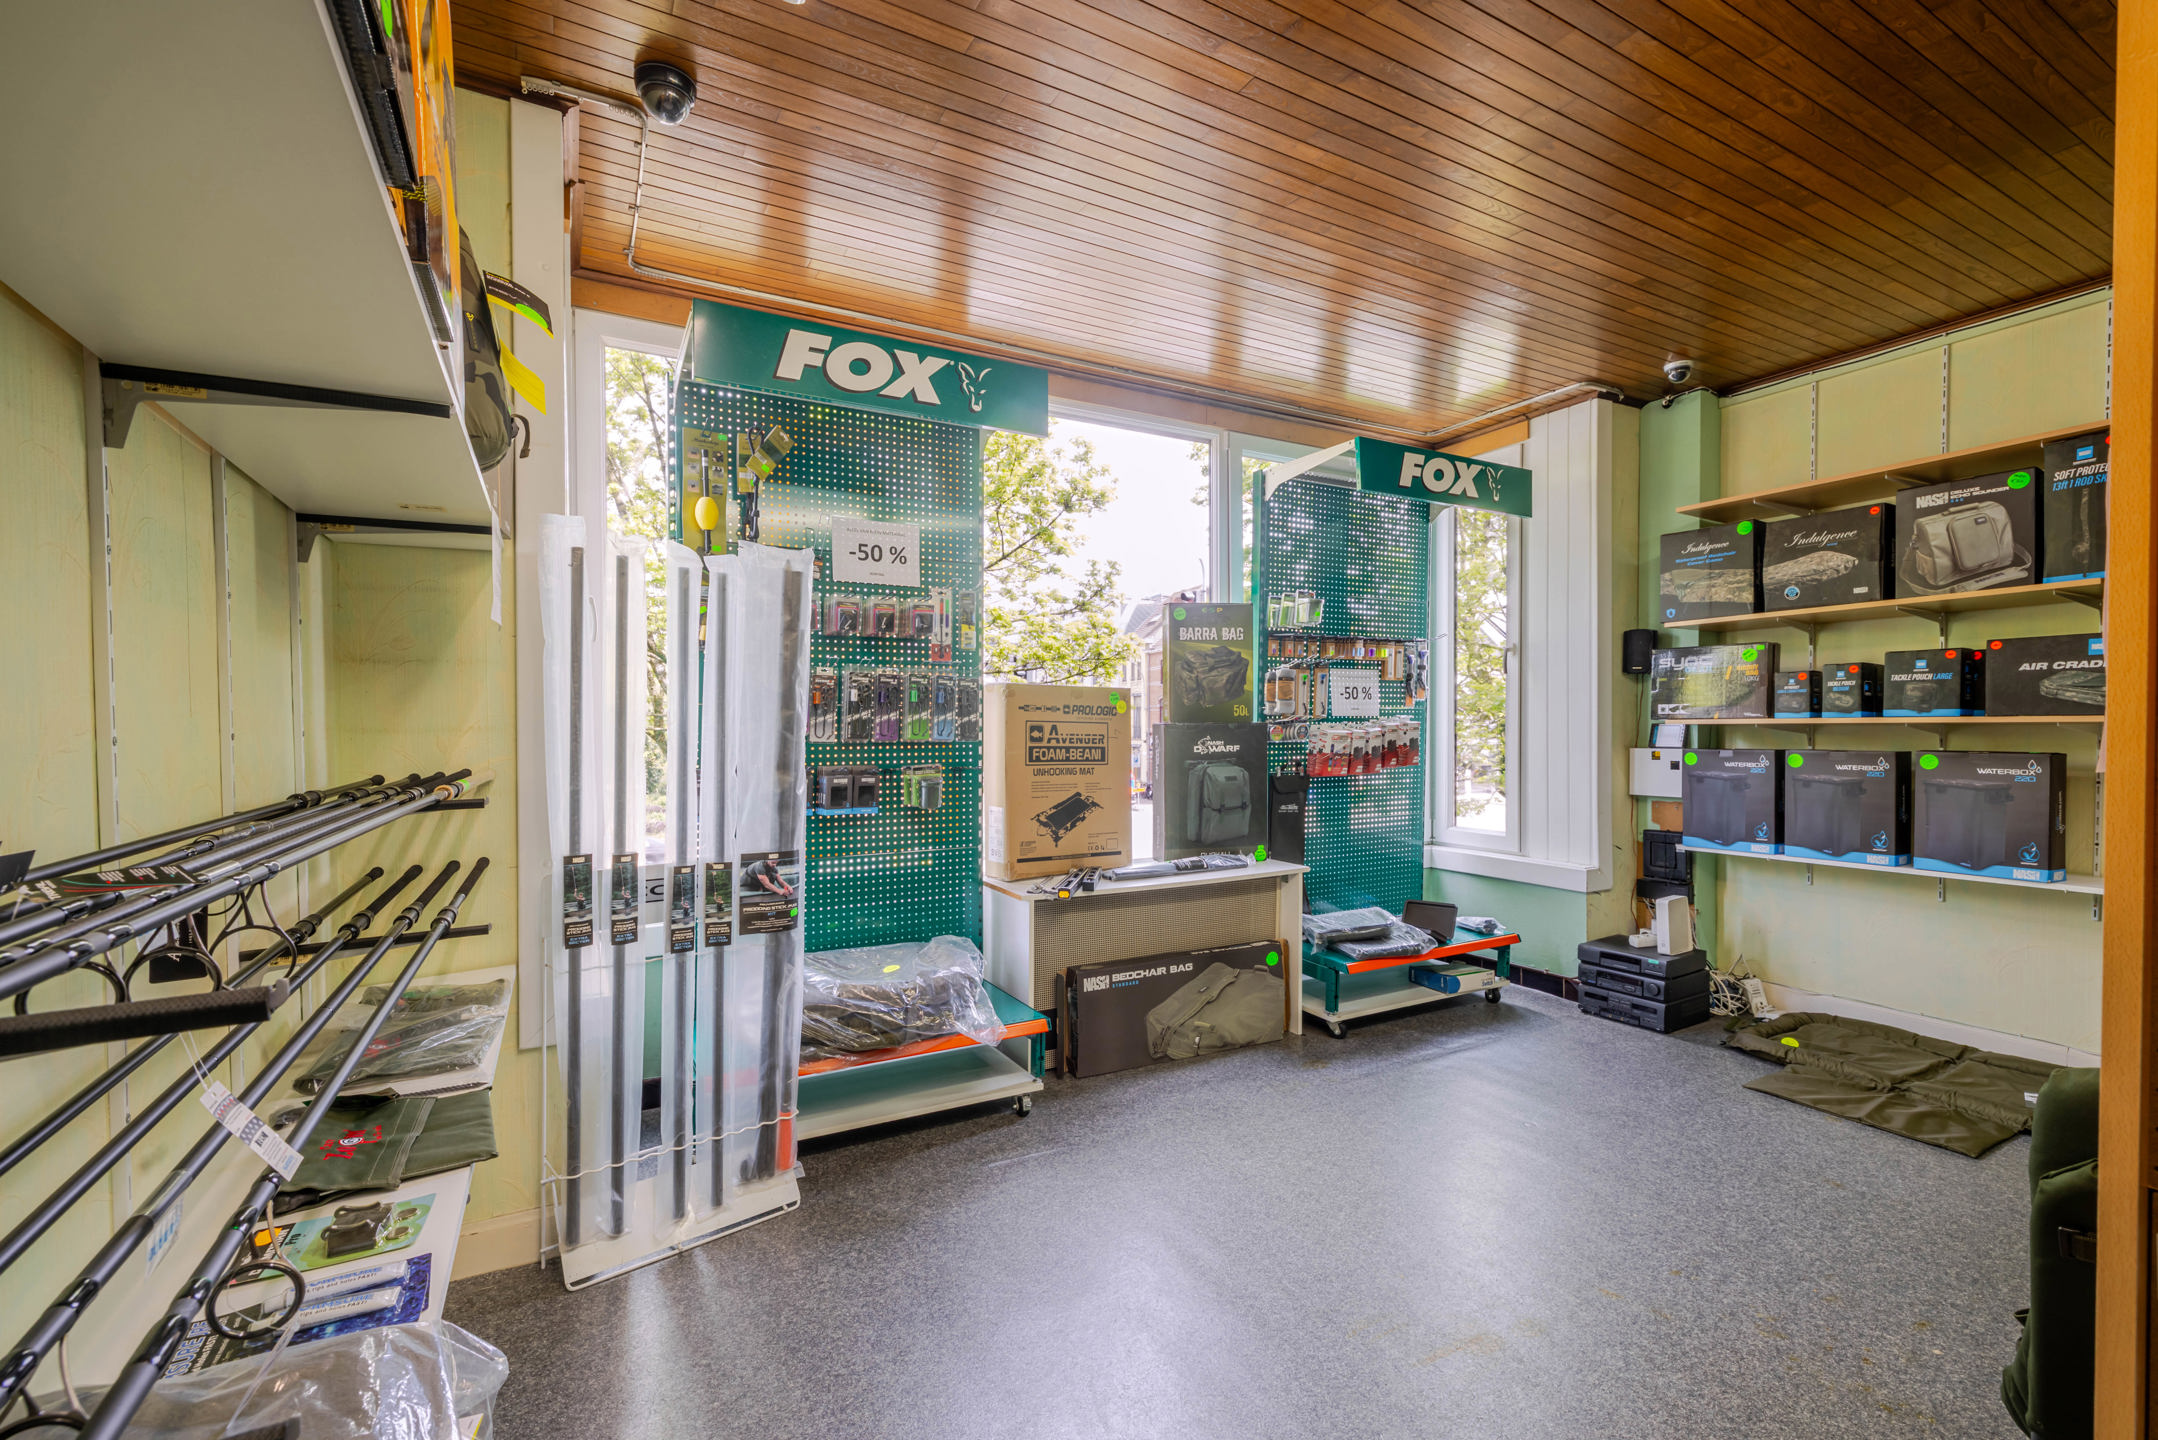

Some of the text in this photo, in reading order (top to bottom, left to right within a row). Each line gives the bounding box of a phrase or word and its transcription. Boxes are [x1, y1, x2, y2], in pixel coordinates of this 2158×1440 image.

[774, 328, 951, 406] FOX
[1399, 451, 1482, 498] FOX
[2053, 468, 2076, 481] SOFT
[2074, 476, 2094, 487] ROD
[1916, 492, 1949, 508] NASH
[1784, 529, 1858, 547] Indulgence
[849, 543, 907, 565] -50 %
[1681, 541, 1729, 554] Indulgence
[1179, 627, 1244, 641] BARRA BAG
[2018, 662, 2049, 672] AIR
[1890, 672, 1953, 681] TACKLE POUCH LARGE
[1340, 685, 1373, 701] -50 %
[1072, 704, 1118, 716] PROLOGIC
[1032, 767, 1095, 777] UNHOOKING MAT
[1976, 767, 2036, 777] WATERBOX
[1083, 963, 1193, 993] NASH BEDCHAIR BAG
